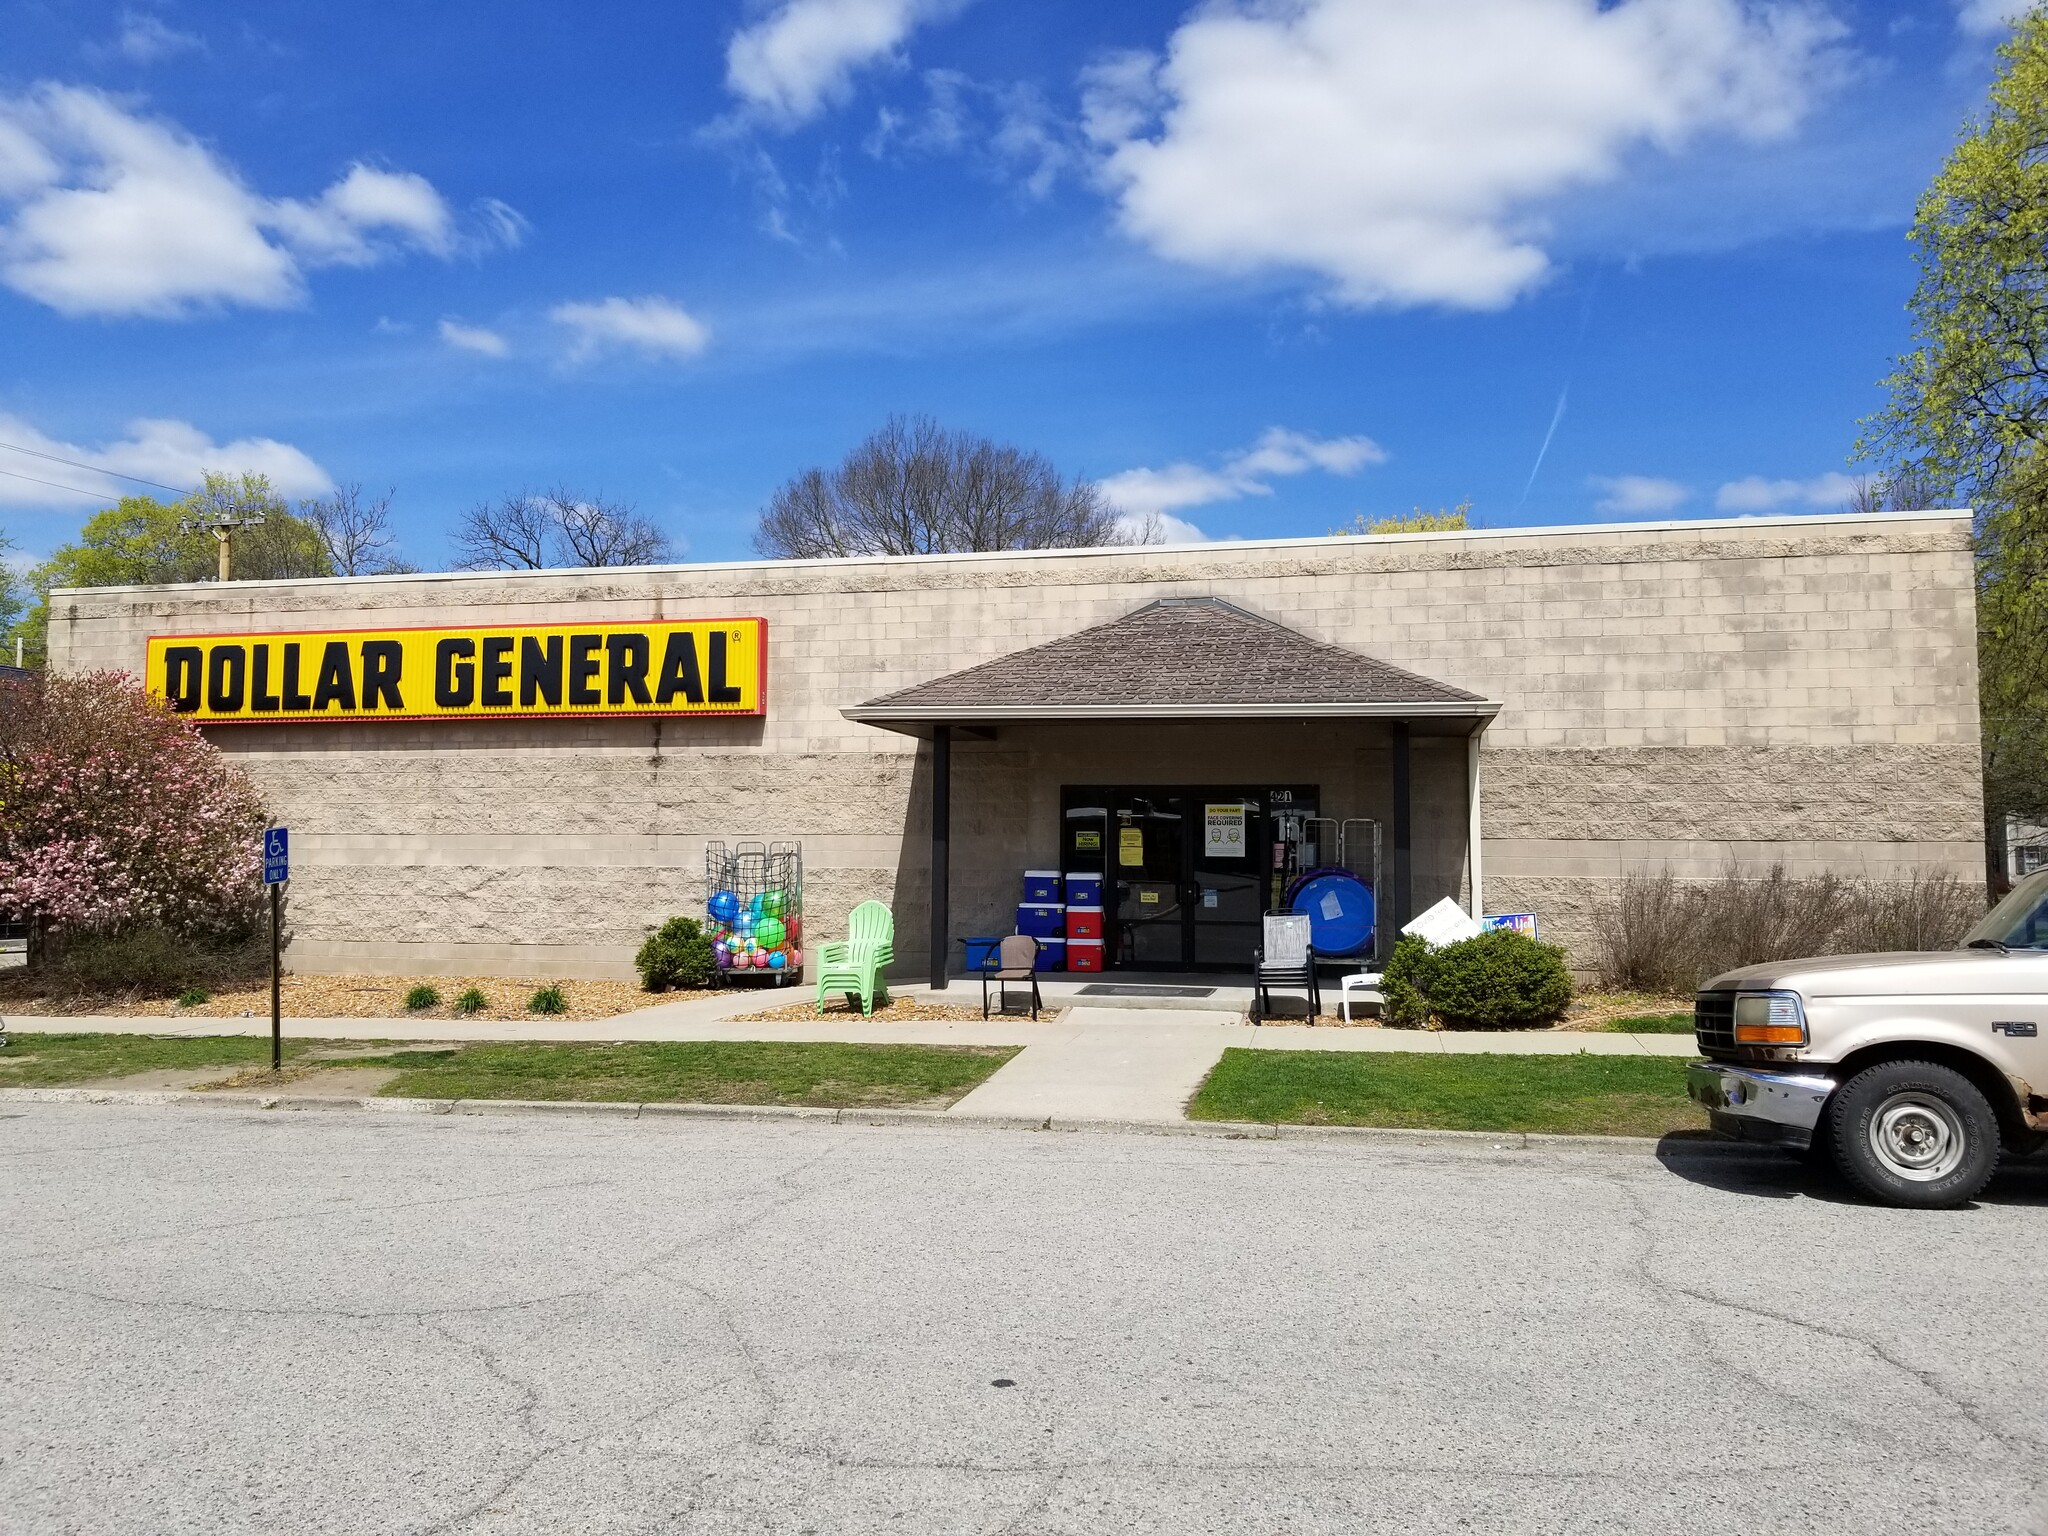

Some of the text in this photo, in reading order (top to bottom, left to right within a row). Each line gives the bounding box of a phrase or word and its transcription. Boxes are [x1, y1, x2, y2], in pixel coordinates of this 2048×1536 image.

[164, 640, 404, 712] DOLLAR
[434, 630, 741, 708] GENERAL
[1270, 790, 1292, 803] 421
[266, 855, 287, 869] PARKING
[269, 868, 284, 881] ONLY
[1411, 914, 1435, 932] COVID
